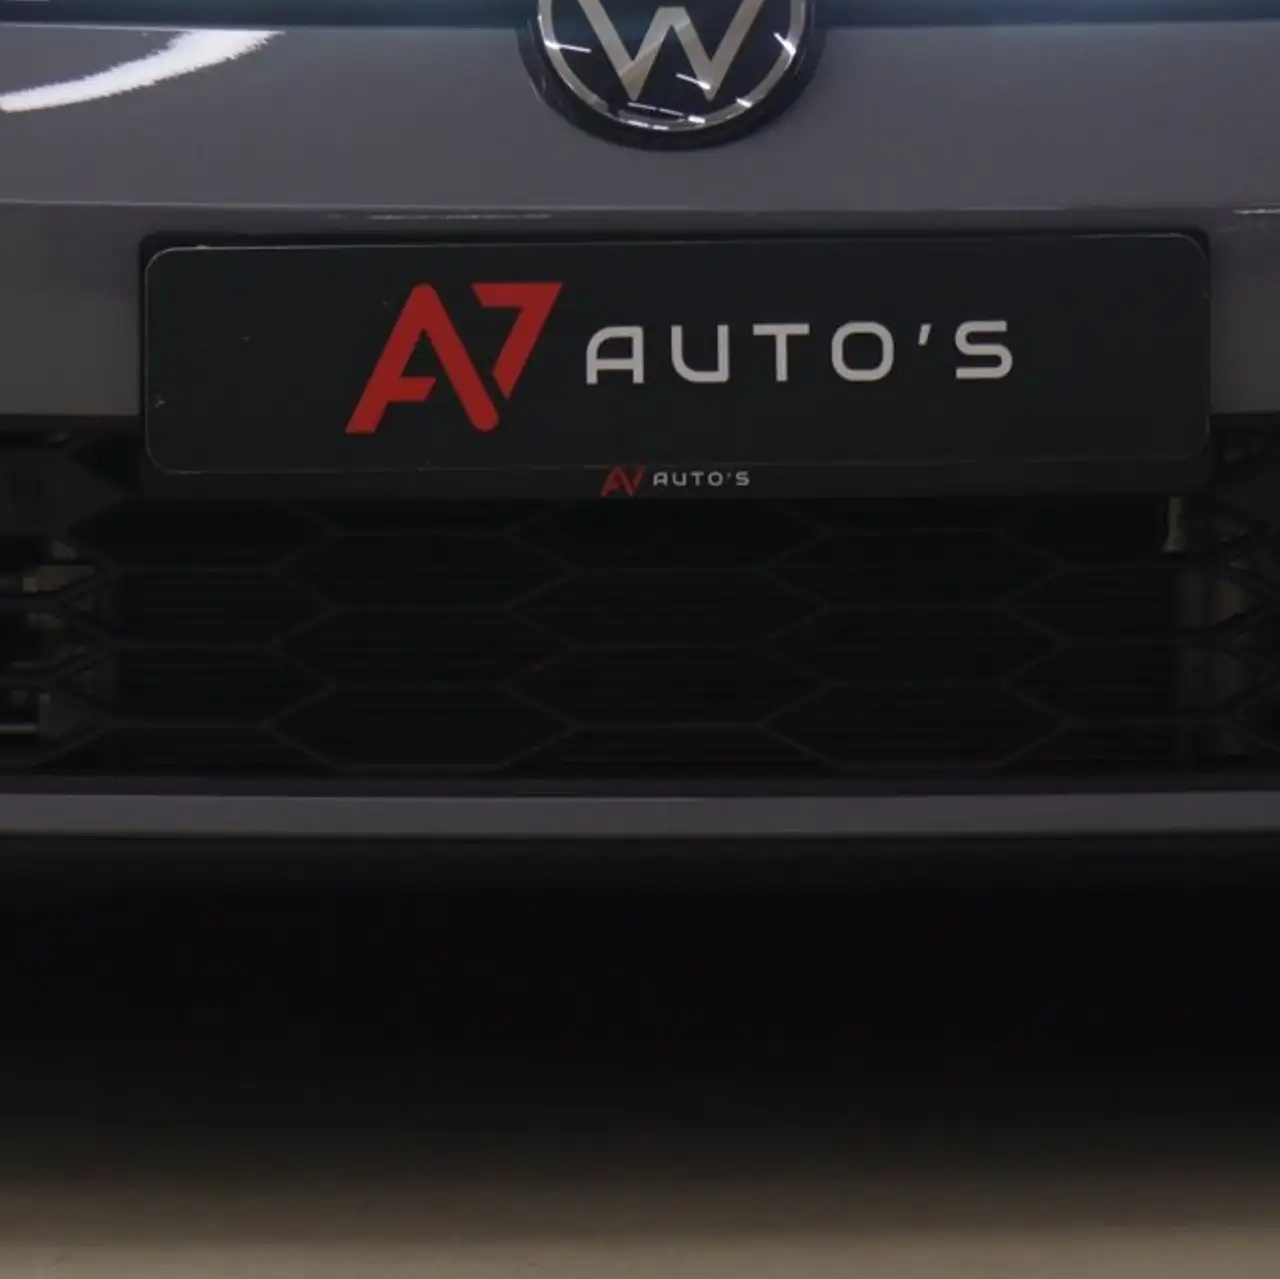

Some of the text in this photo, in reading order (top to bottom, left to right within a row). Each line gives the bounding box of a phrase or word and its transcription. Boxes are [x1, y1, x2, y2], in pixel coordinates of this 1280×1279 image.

[345, 281, 1014, 435] A7 AUTO'S
[652, 470, 751, 488] AUTO'S
